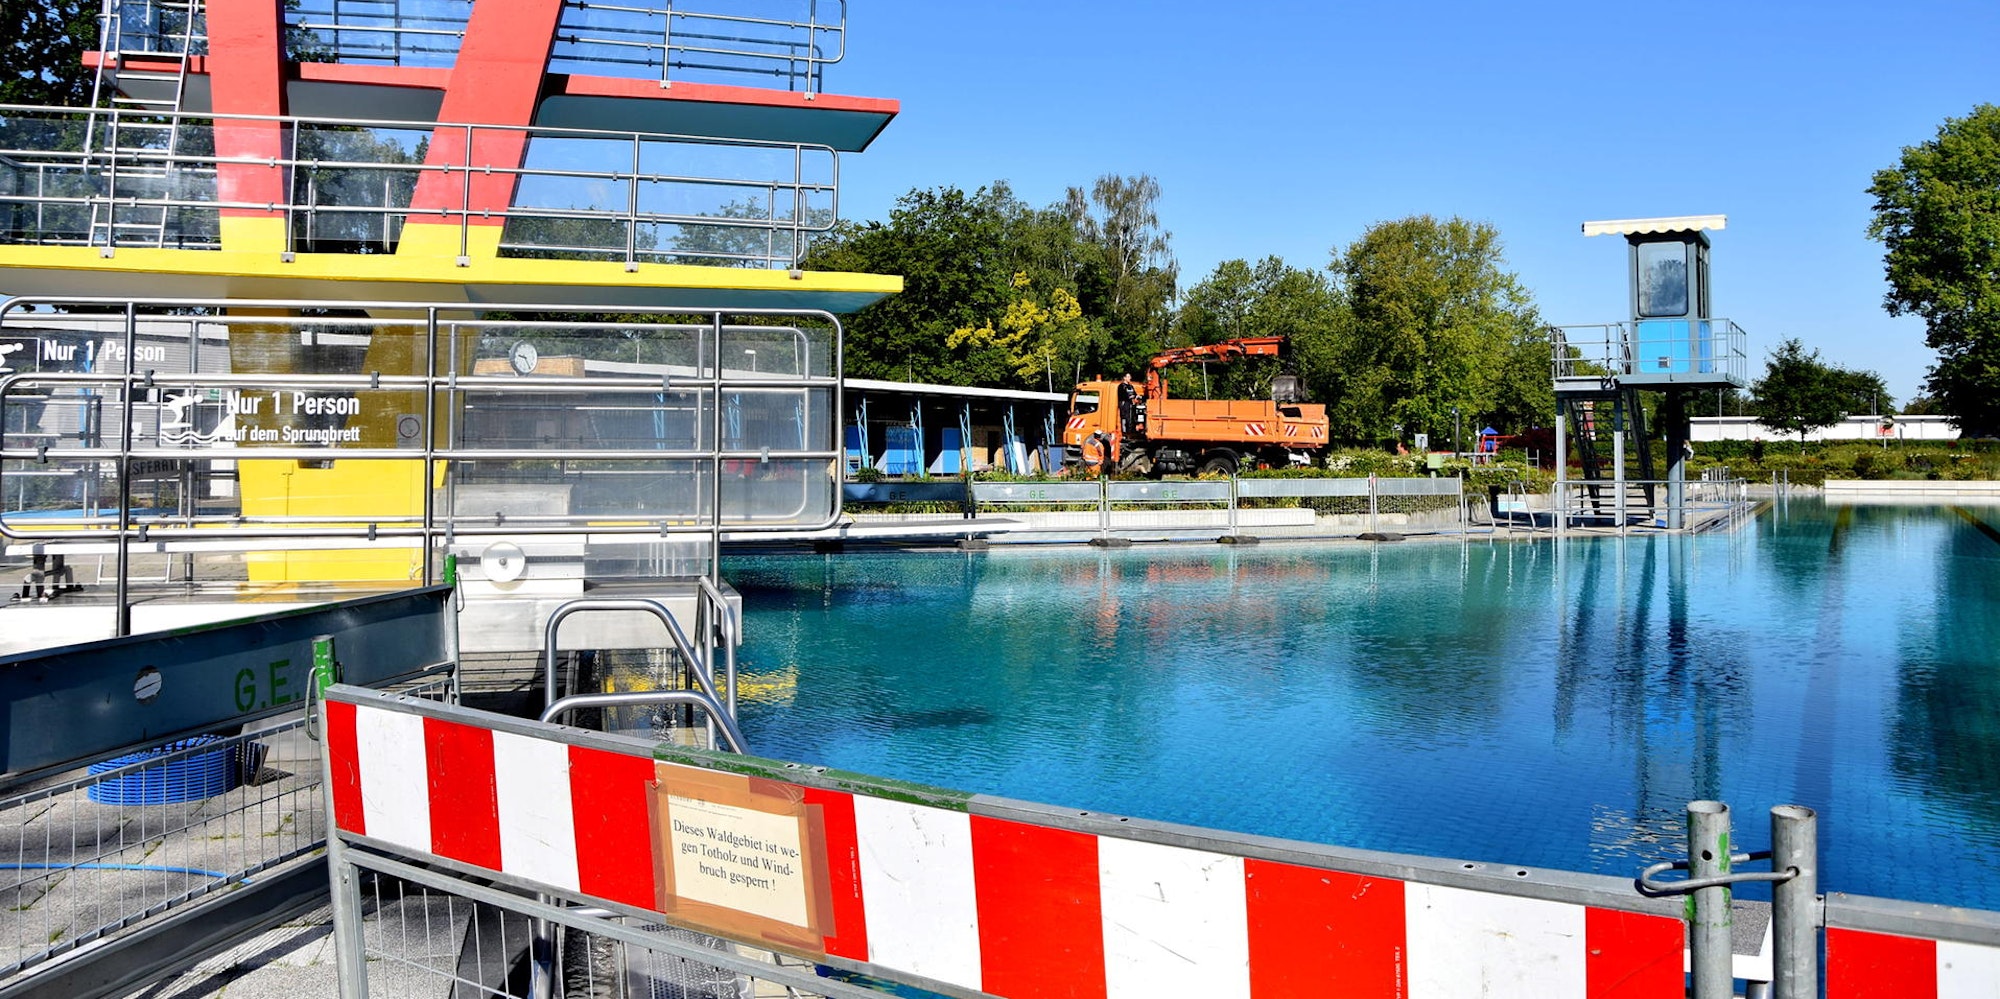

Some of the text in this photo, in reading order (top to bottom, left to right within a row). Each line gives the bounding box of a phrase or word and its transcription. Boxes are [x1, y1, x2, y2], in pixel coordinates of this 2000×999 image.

[44, 339, 166, 362] Nur 1 Peson
[226, 390, 360, 415] Nur 1 Person
[250, 425, 278, 441] dem
[282, 425, 360, 444] Sprungbrett
[234, 659, 300, 713] G.E.
[673, 819, 800, 859] Dieses Waldgebiet ist we-
[681, 841, 795, 876] gen Totholz und Wind-
[699, 861, 727, 879] bruch
[729, 871, 769, 890] gesperrt
